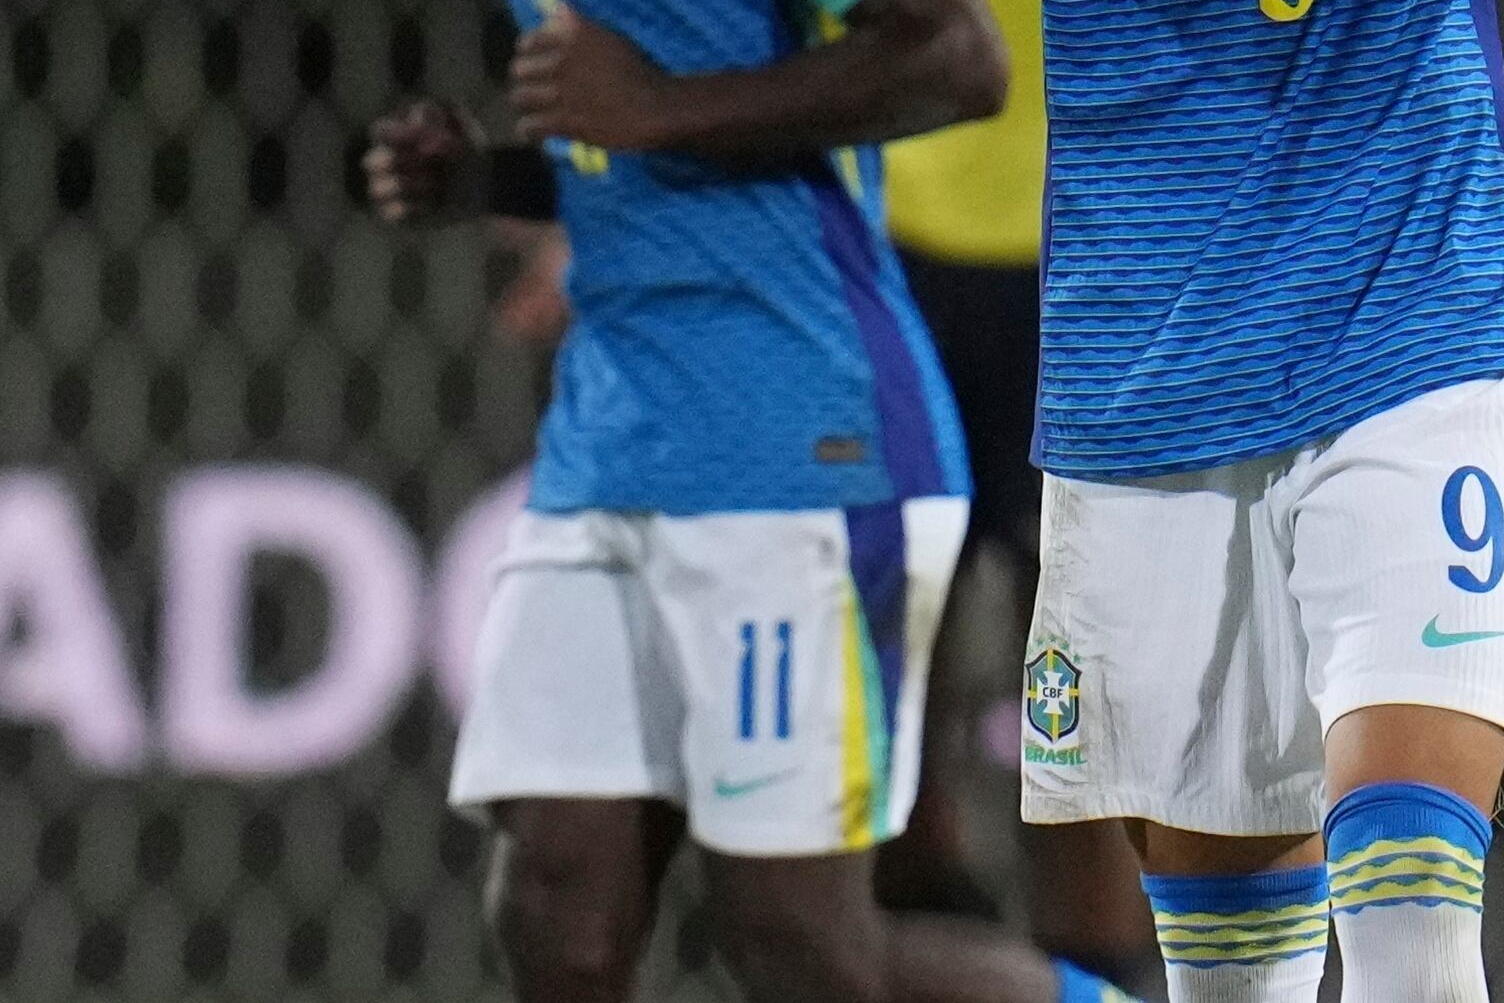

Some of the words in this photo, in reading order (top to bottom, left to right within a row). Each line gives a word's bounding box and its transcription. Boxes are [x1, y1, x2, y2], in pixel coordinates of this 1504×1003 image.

[738, 620, 794, 741] 11
[1042, 686, 1064, 698] CBF
[1025, 744, 1088, 765] BRASIL
